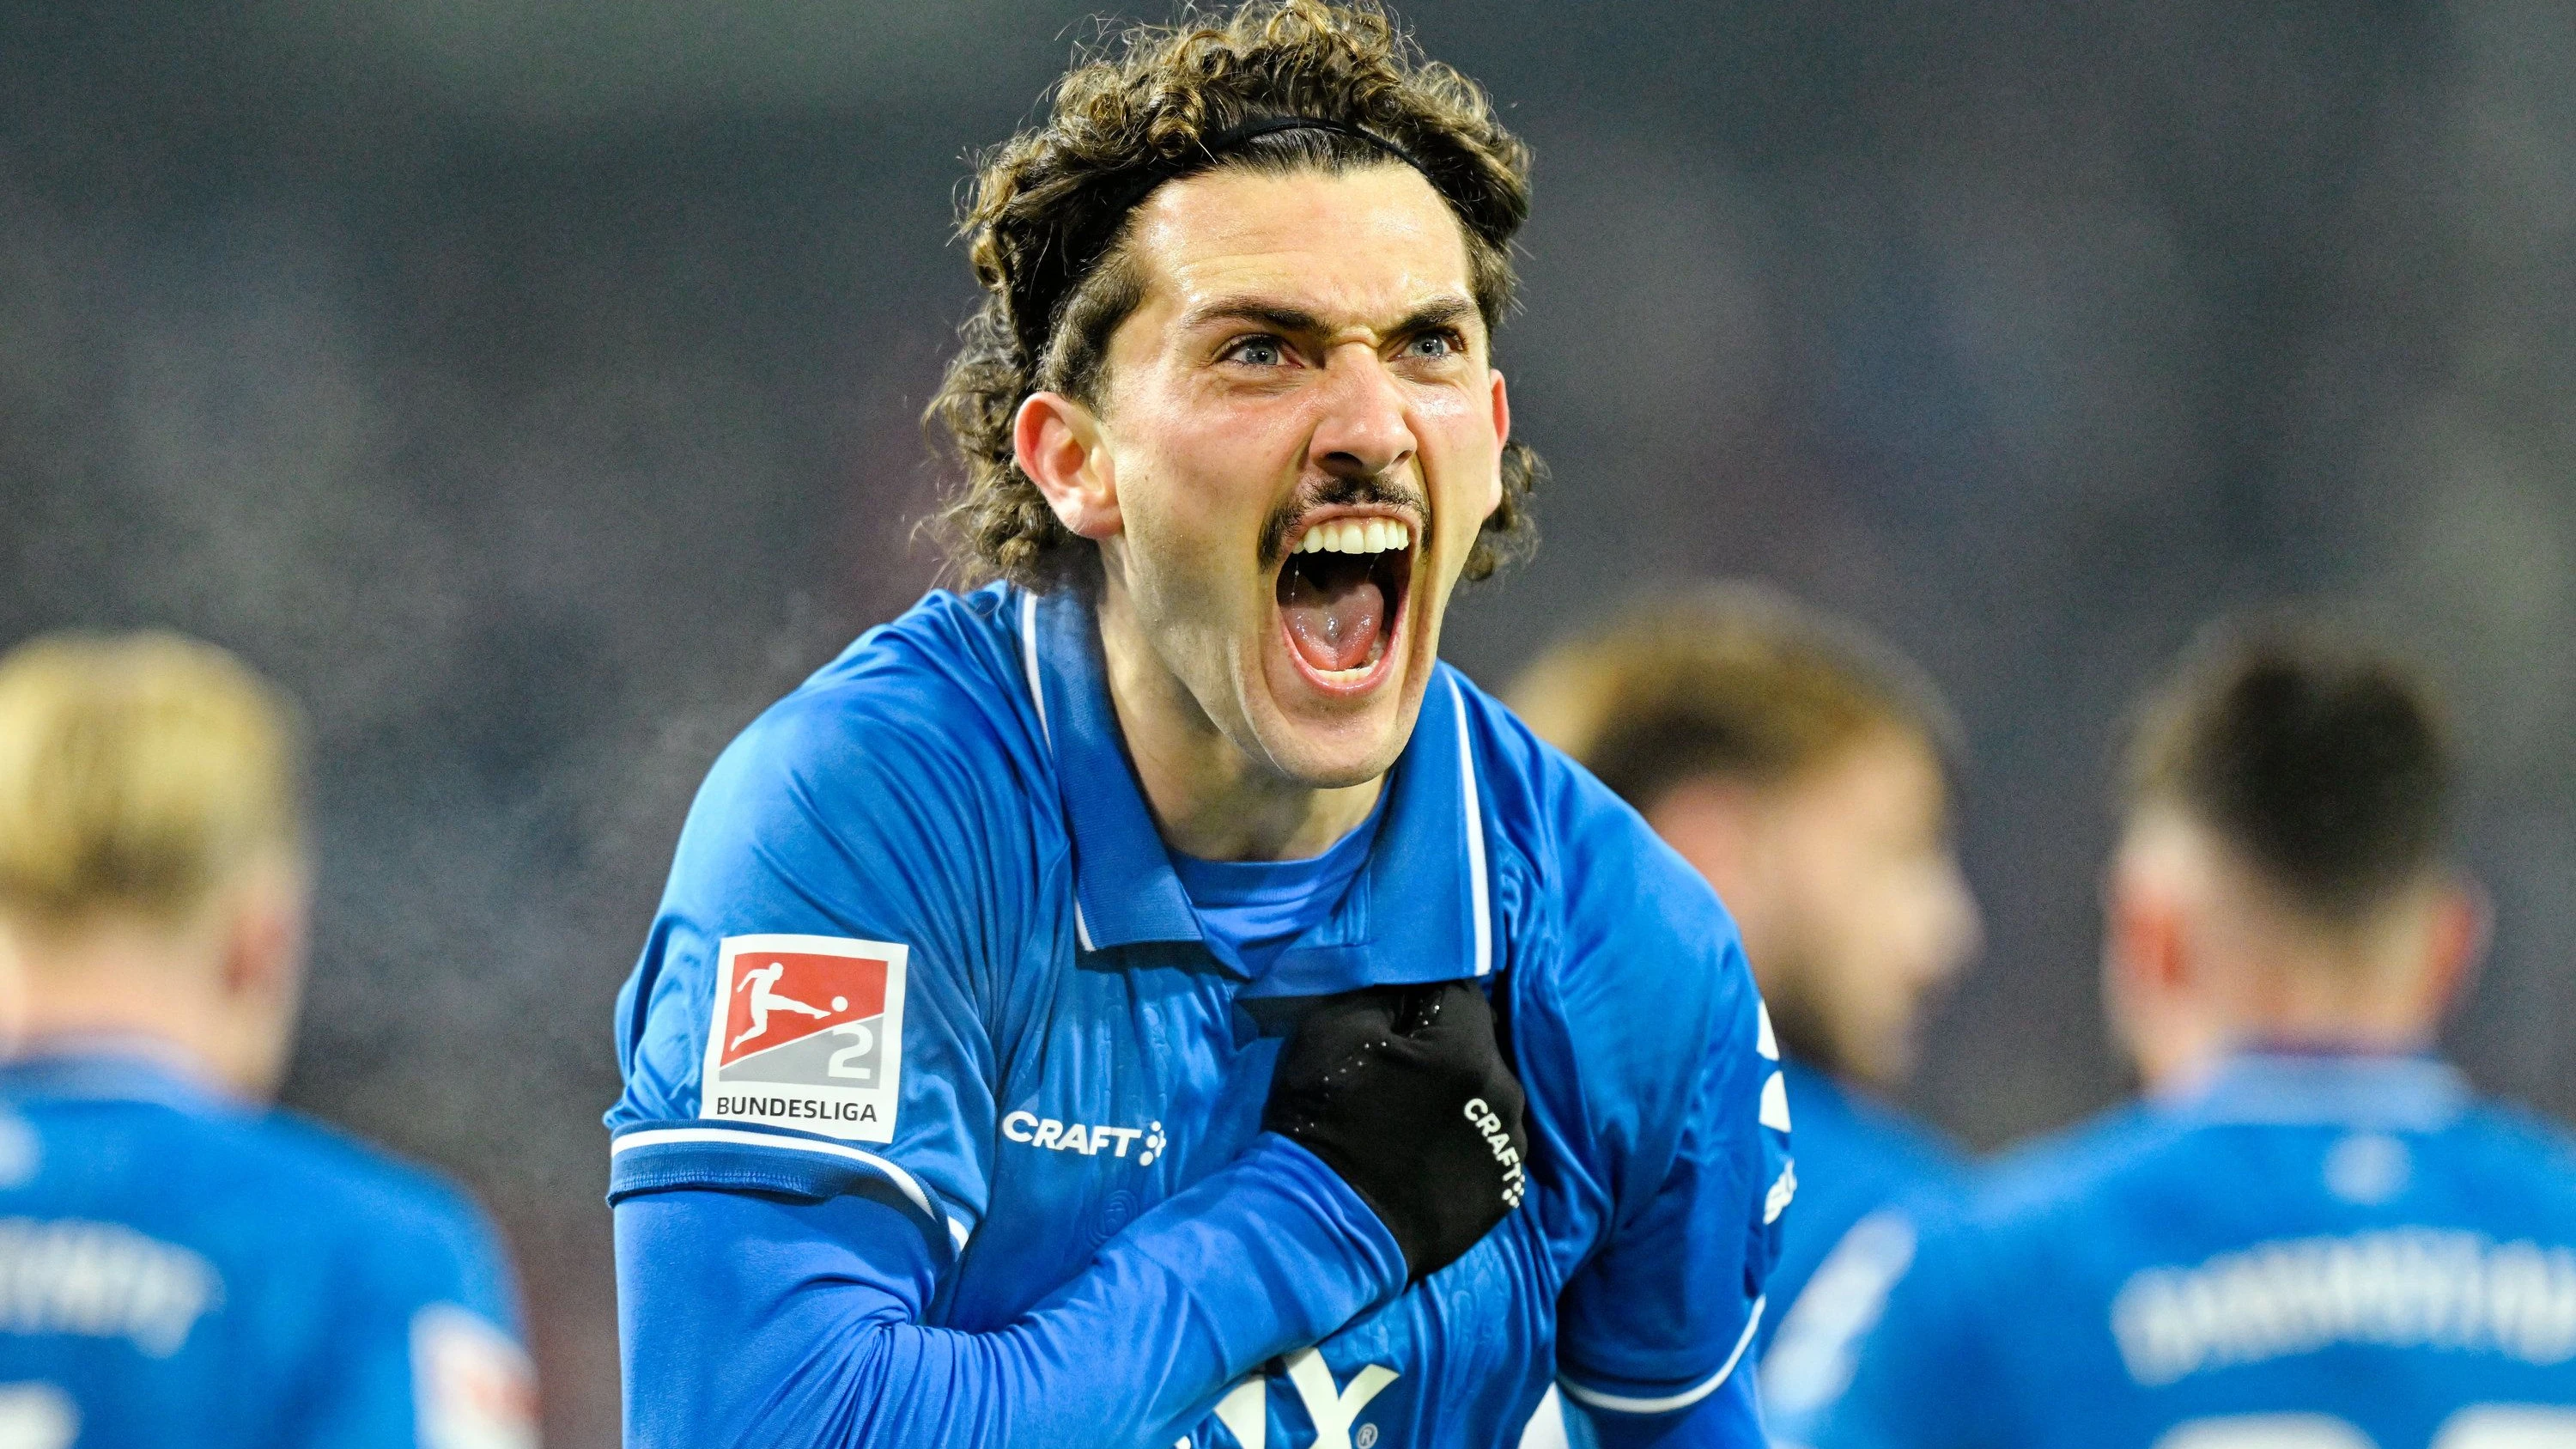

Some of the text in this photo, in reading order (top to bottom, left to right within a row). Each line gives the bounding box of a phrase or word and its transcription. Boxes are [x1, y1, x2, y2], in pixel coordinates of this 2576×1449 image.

[829, 1023, 873, 1080] 2
[716, 1096, 878, 1123] BUNDESLIGA
[1003, 1111, 1142, 1157] CRAFT
[1464, 1098, 1522, 1182] CRAFT
